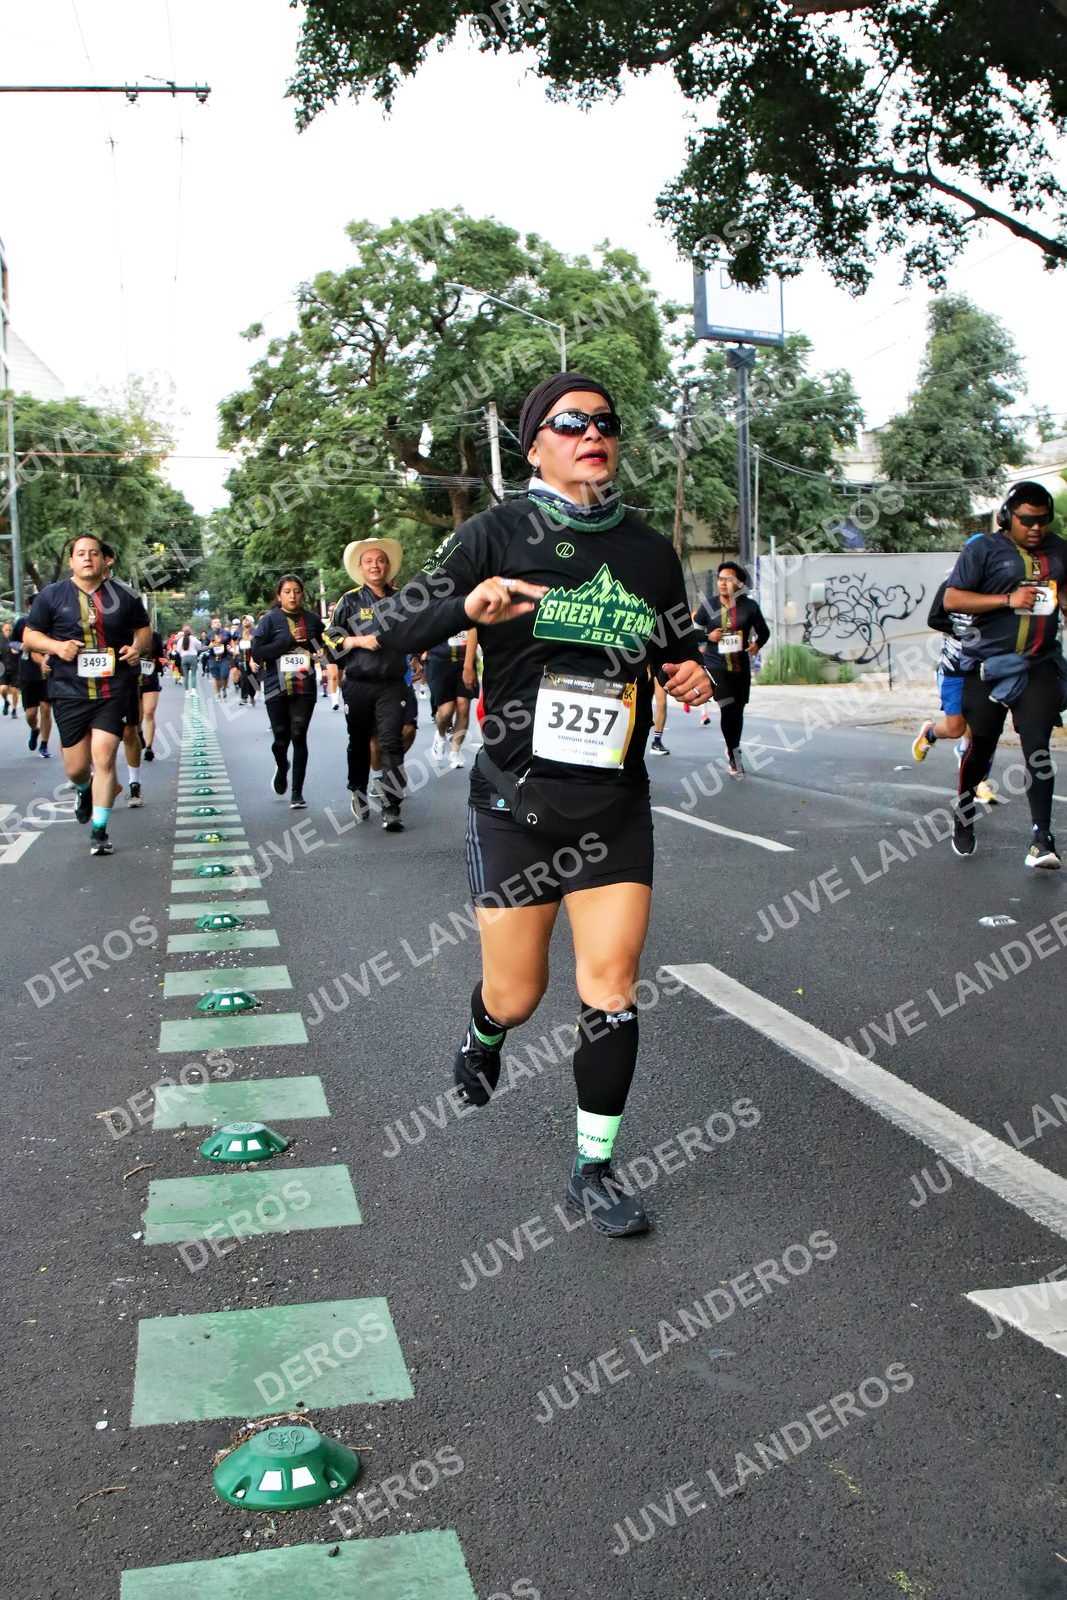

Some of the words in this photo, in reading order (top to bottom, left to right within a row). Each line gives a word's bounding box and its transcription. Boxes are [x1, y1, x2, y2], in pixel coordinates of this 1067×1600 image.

[826, 573, 867, 587] TOY
[592, 632, 625, 645] GDL
[721, 637, 739, 646] 7036
[83, 657, 107, 667] 3493
[285, 656, 304, 666] 5430
[547, 701, 619, 736] 3257
